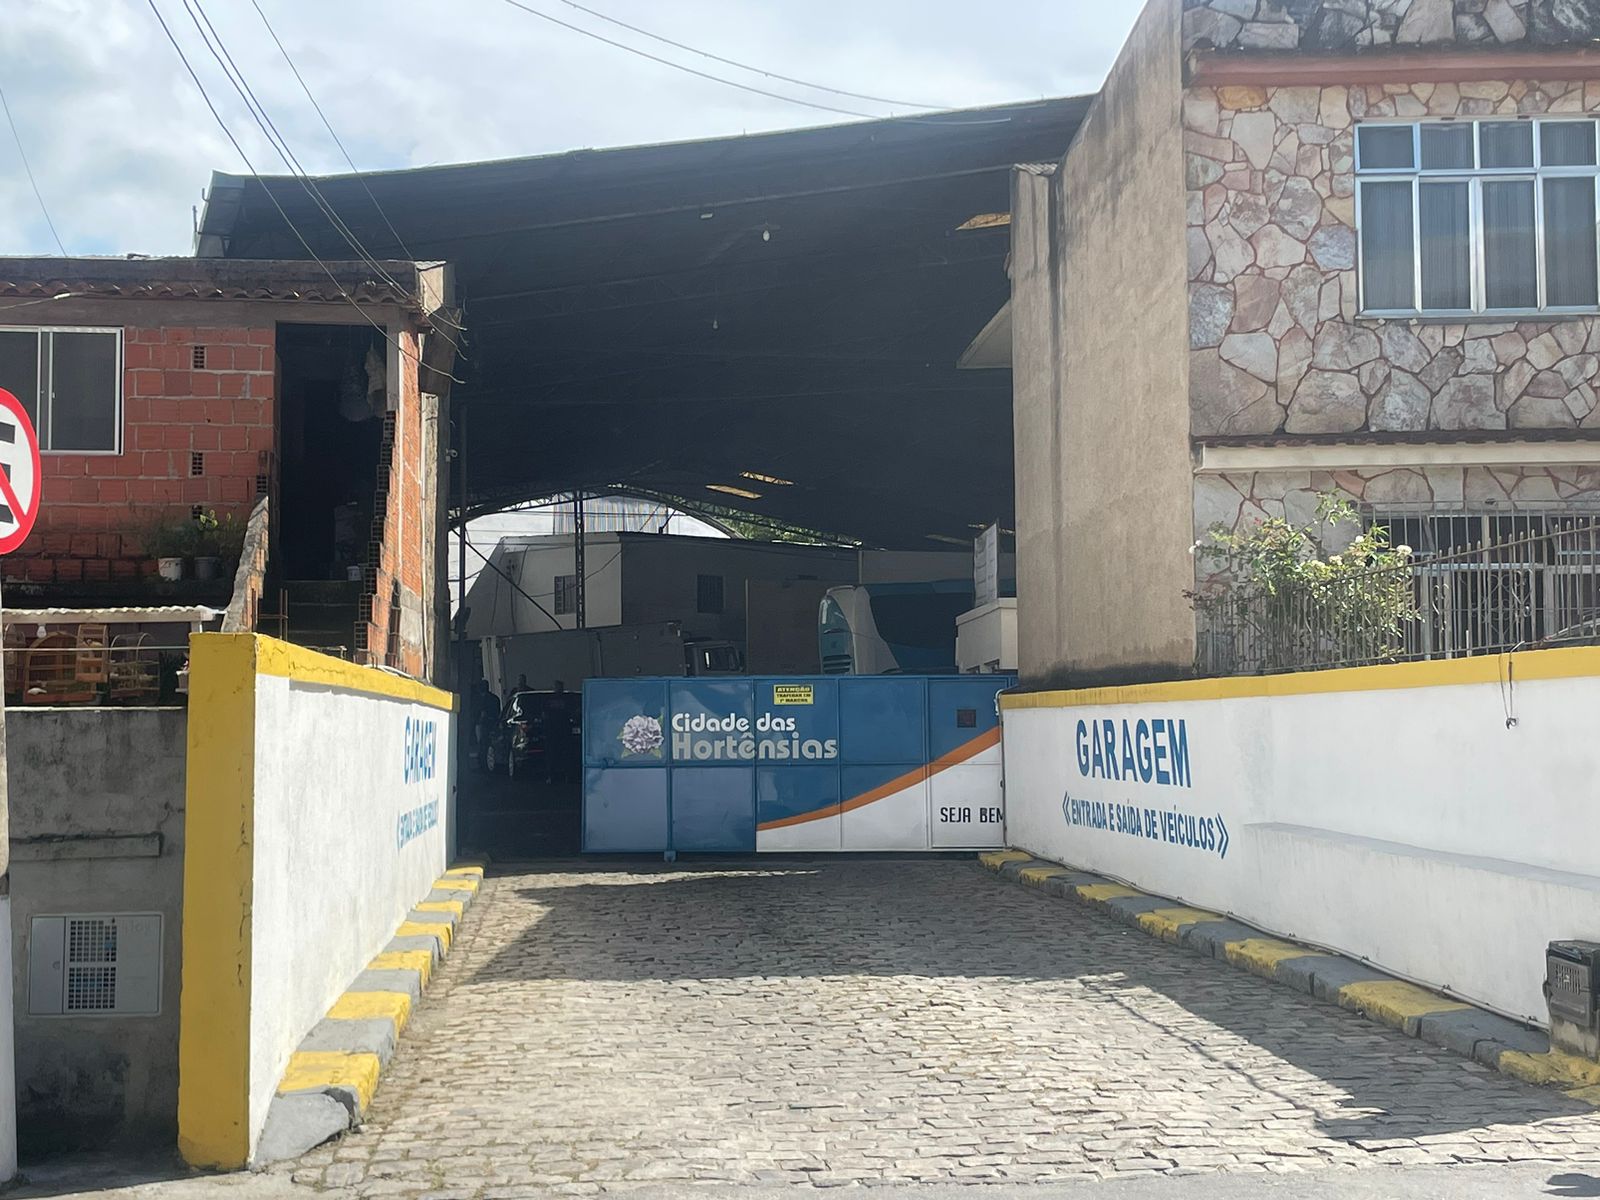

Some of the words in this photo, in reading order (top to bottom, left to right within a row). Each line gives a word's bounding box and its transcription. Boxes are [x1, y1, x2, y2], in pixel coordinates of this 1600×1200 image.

[671, 712, 750, 732] Cidade
[756, 712, 796, 732] das
[672, 731, 838, 760] Hortênsias
[1076, 718, 1192, 788] GARAGEM
[940, 807, 971, 823] SEJA
[1071, 798, 1108, 830] ENTRADA
[1108, 802, 1115, 832] E
[1116, 798, 1143, 838] SAÍDA
[1144, 808, 1158, 840] DE
[1159, 804, 1215, 851] VEÍCULOS
